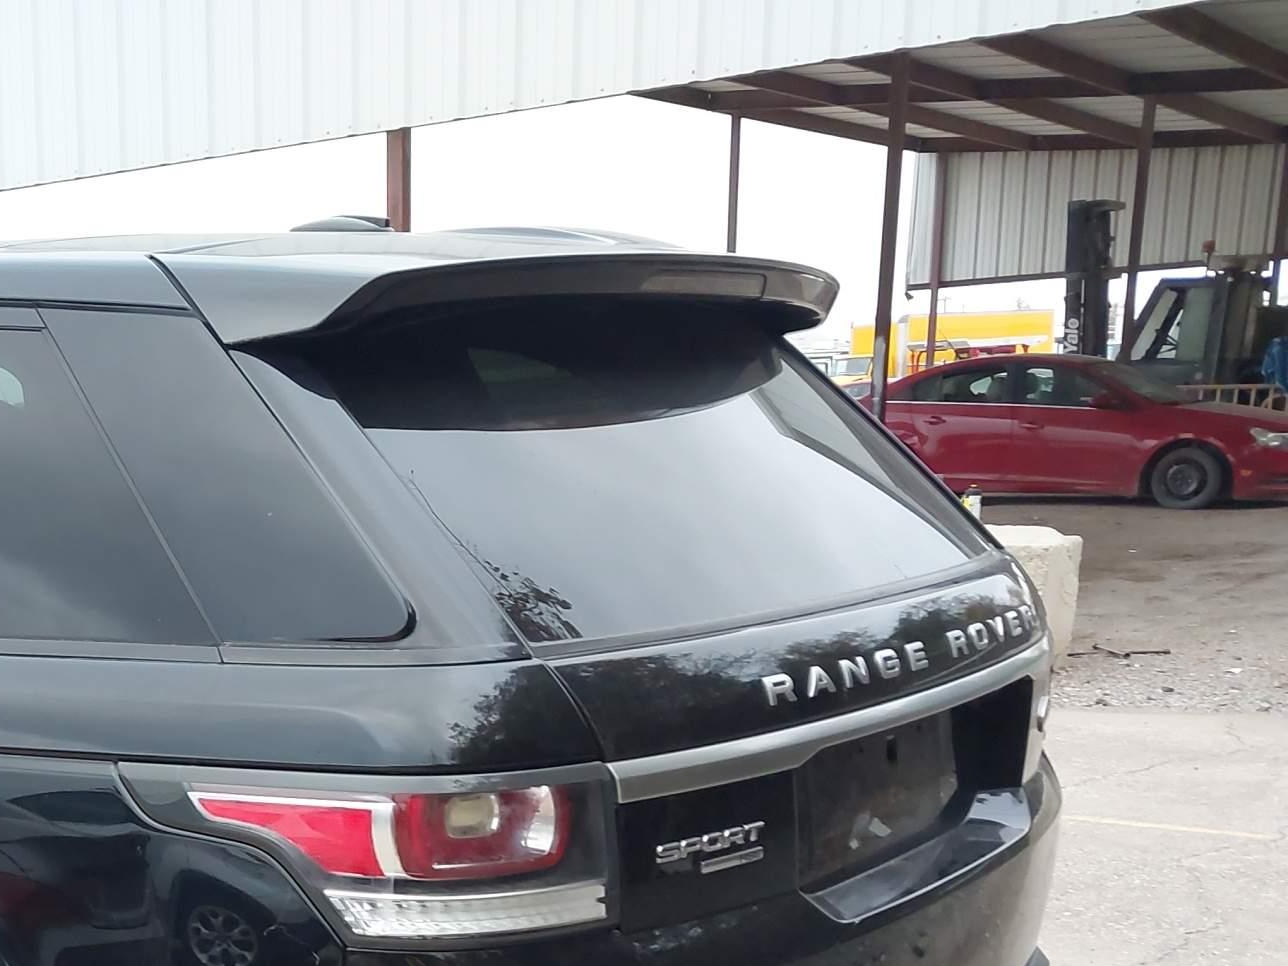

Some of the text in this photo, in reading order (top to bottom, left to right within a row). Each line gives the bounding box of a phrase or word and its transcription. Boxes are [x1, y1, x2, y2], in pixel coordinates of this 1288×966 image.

[761, 604, 1037, 706] RANGE ROVER
[655, 820, 766, 864] SPORT
